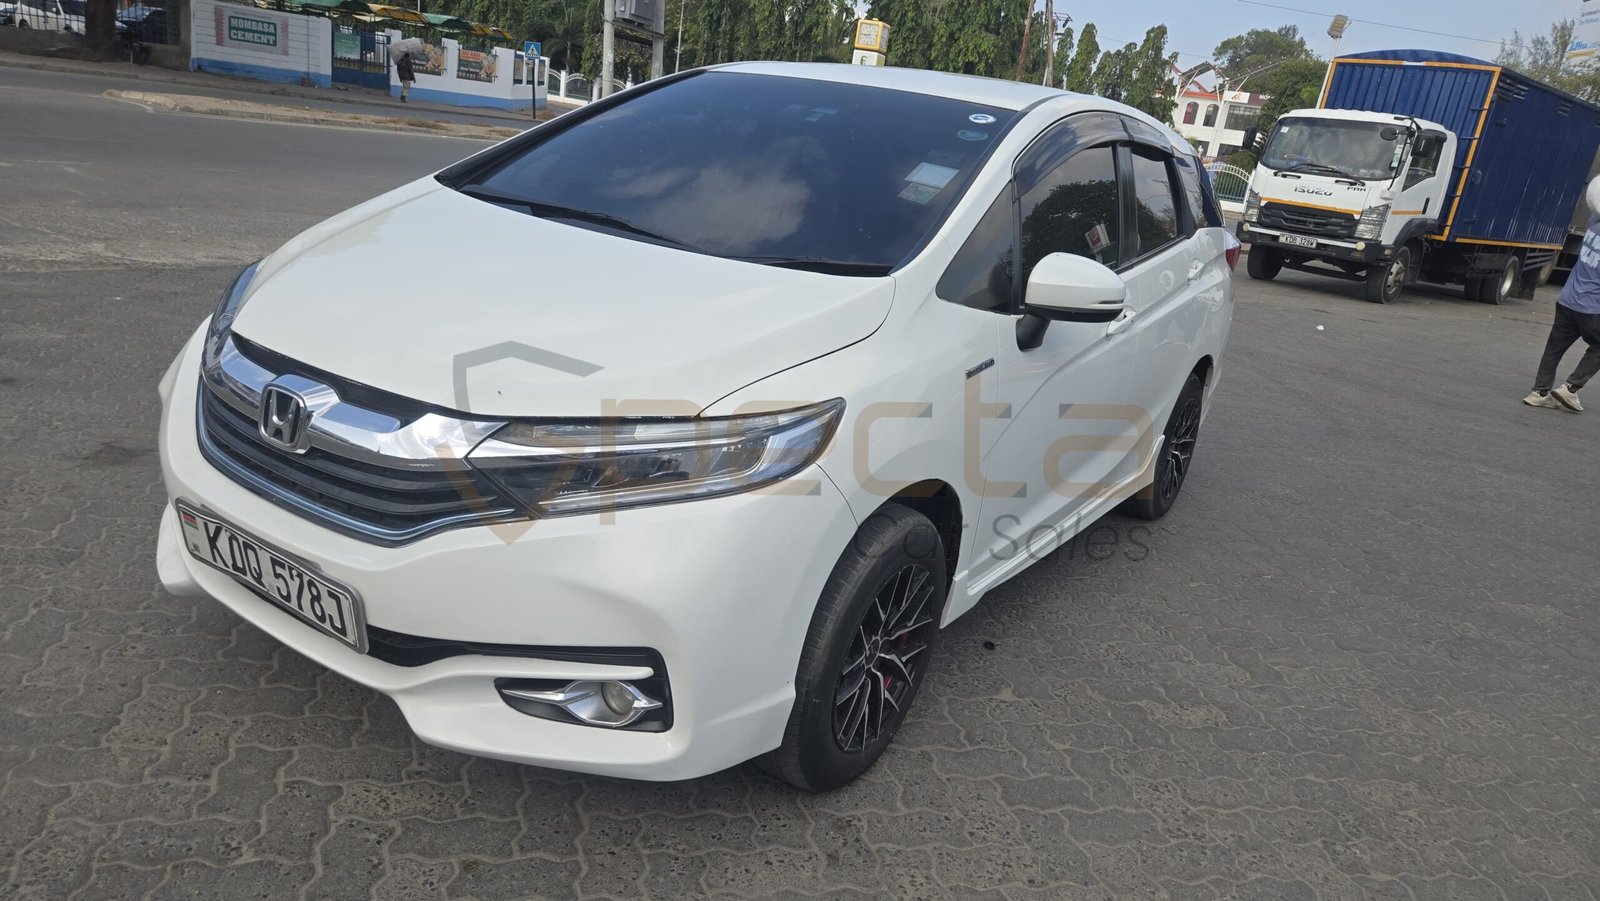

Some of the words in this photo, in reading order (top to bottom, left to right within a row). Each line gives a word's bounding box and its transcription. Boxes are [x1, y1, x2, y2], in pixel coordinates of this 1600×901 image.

[230, 17, 275, 33] MOMBASA
[230, 30, 275, 45] CEMENT
[1294, 184, 1334, 197] ISUZU
[203, 521, 269, 593] KDQ
[269, 554, 348, 639] 578J
